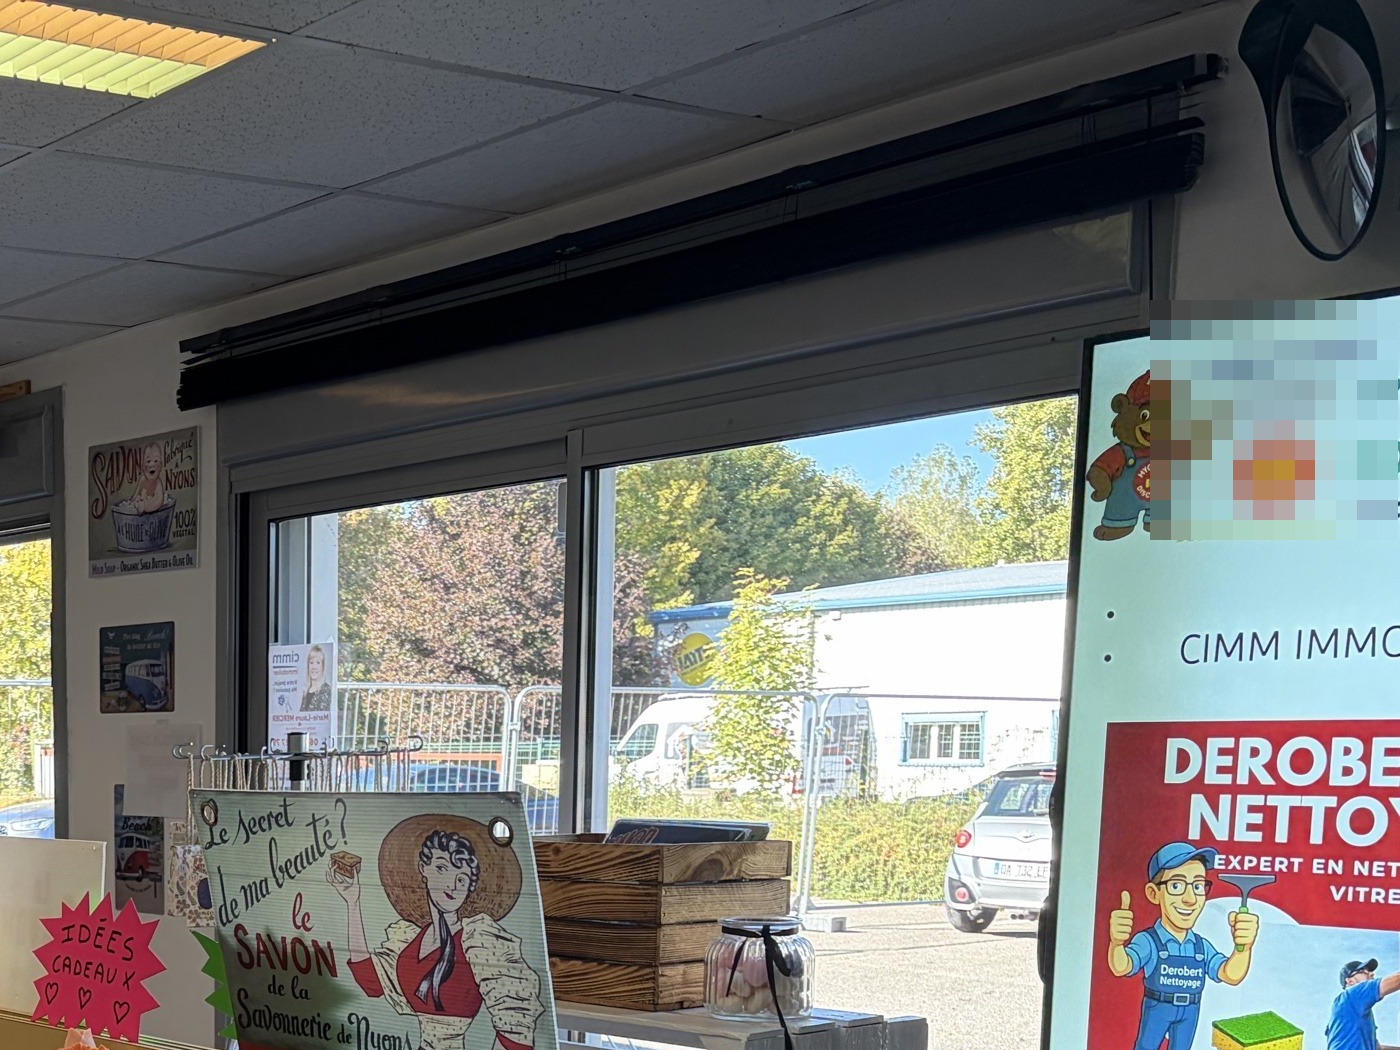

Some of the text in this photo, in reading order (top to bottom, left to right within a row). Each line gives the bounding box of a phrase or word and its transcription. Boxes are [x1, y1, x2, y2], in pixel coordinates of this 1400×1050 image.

[92, 446, 142, 519] SAVON
[165, 468, 195, 491] NYONS
[174, 508, 196, 529] 100%
[121, 561, 139, 572] ORGANIC
[140, 559, 151, 570] SHEA
[152, 557, 168, 569] BUTTER
[172, 555, 185, 567] OLIVE
[1180, 630, 1279, 665] CIMM
[1164, 736, 1400, 787] DEROBE
[122, 816, 151, 831] Beach
[203, 797, 296, 850] Le secret
[1213, 854, 1303, 873] EXPERT
[1312, 859, 1343, 875] EN
[218, 865, 240, 927] de
[240, 877, 271, 911] ma
[292, 892, 314, 932] le
[1330, 885, 1400, 905] VITRE
[61, 918, 134, 961] IDÉES
[234, 923, 338, 977] SAVON
[52, 955, 135, 991] CADEAUX
[267, 974, 311, 1000] de la
[1159, 976, 1201, 989] Nettoyage
[1160, 964, 1203, 977] Derobert
[237, 988, 334, 1041] Savonnerie
[337, 1023, 353, 1045] de
